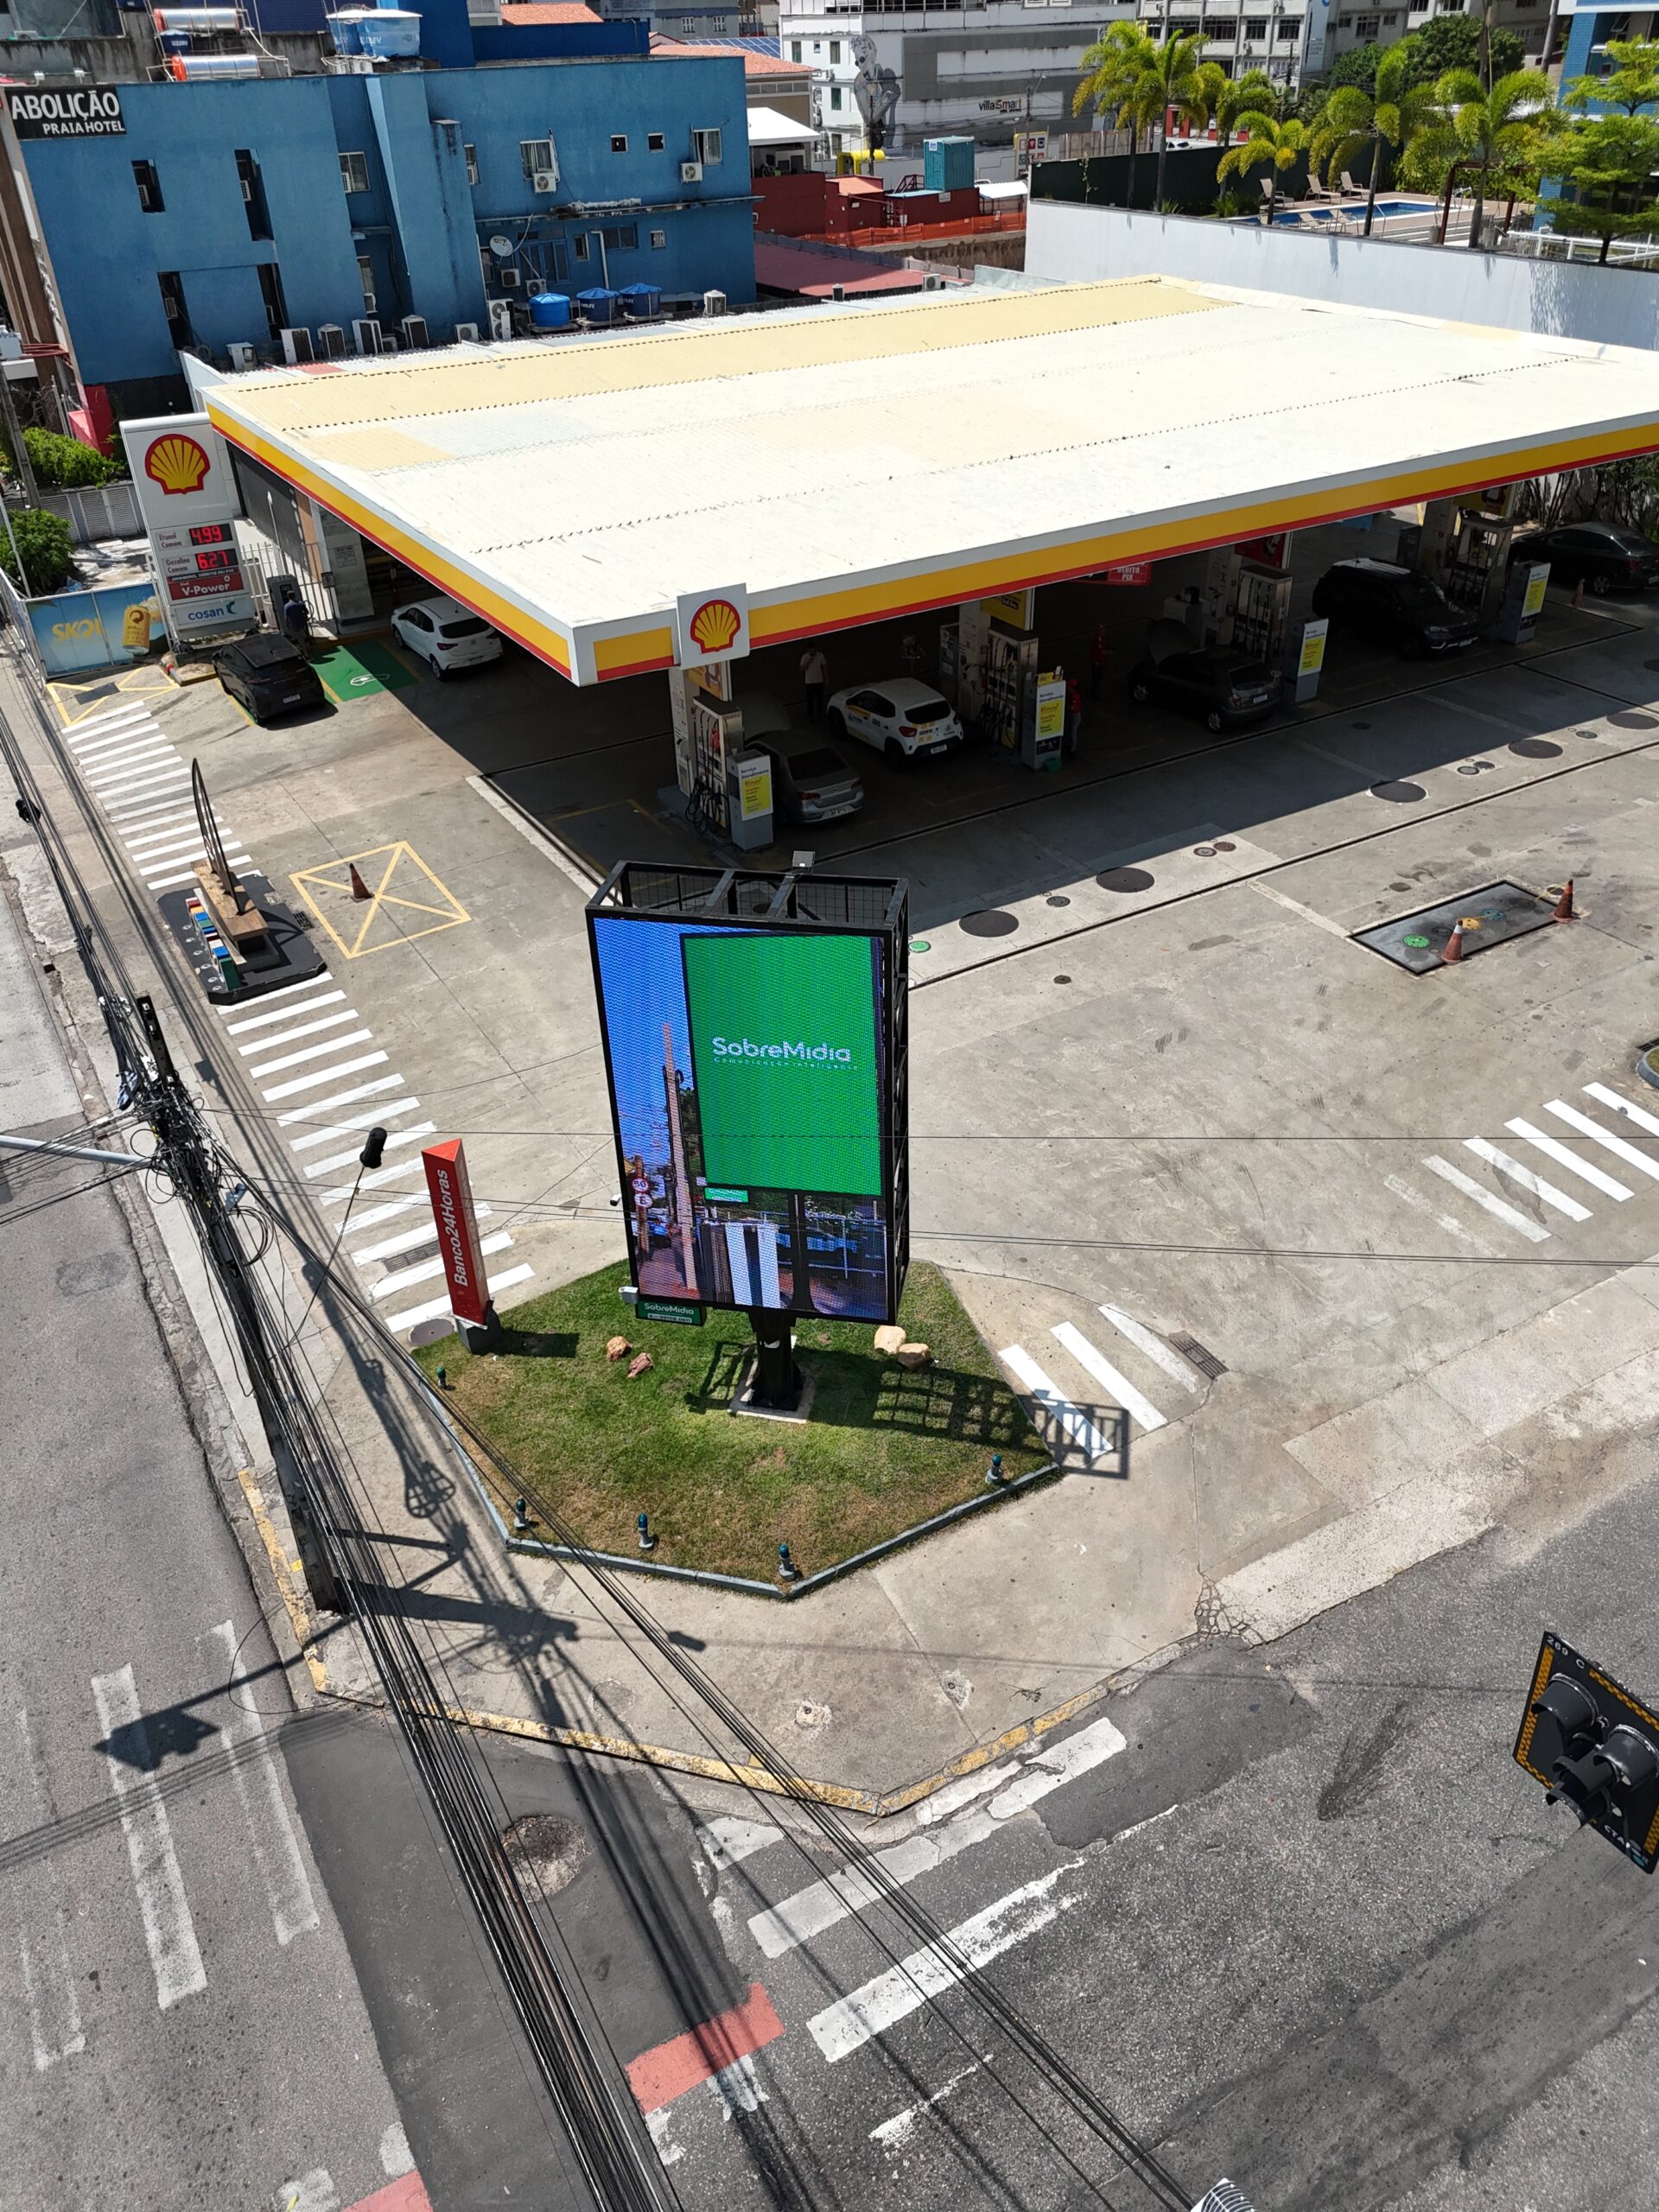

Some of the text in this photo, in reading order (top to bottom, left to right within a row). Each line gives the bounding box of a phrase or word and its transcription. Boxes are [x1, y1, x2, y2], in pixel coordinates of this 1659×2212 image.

[12, 90, 120, 120] ABOLIÇÃO
[1122, 573, 1134, 582] PIX
[181, 583, 230, 596] V-Power
[188, 607, 225, 620] cosan
[436, 1168, 468, 1287] Banco24Horas
[1547, 1636, 1585, 1669] 269 C
